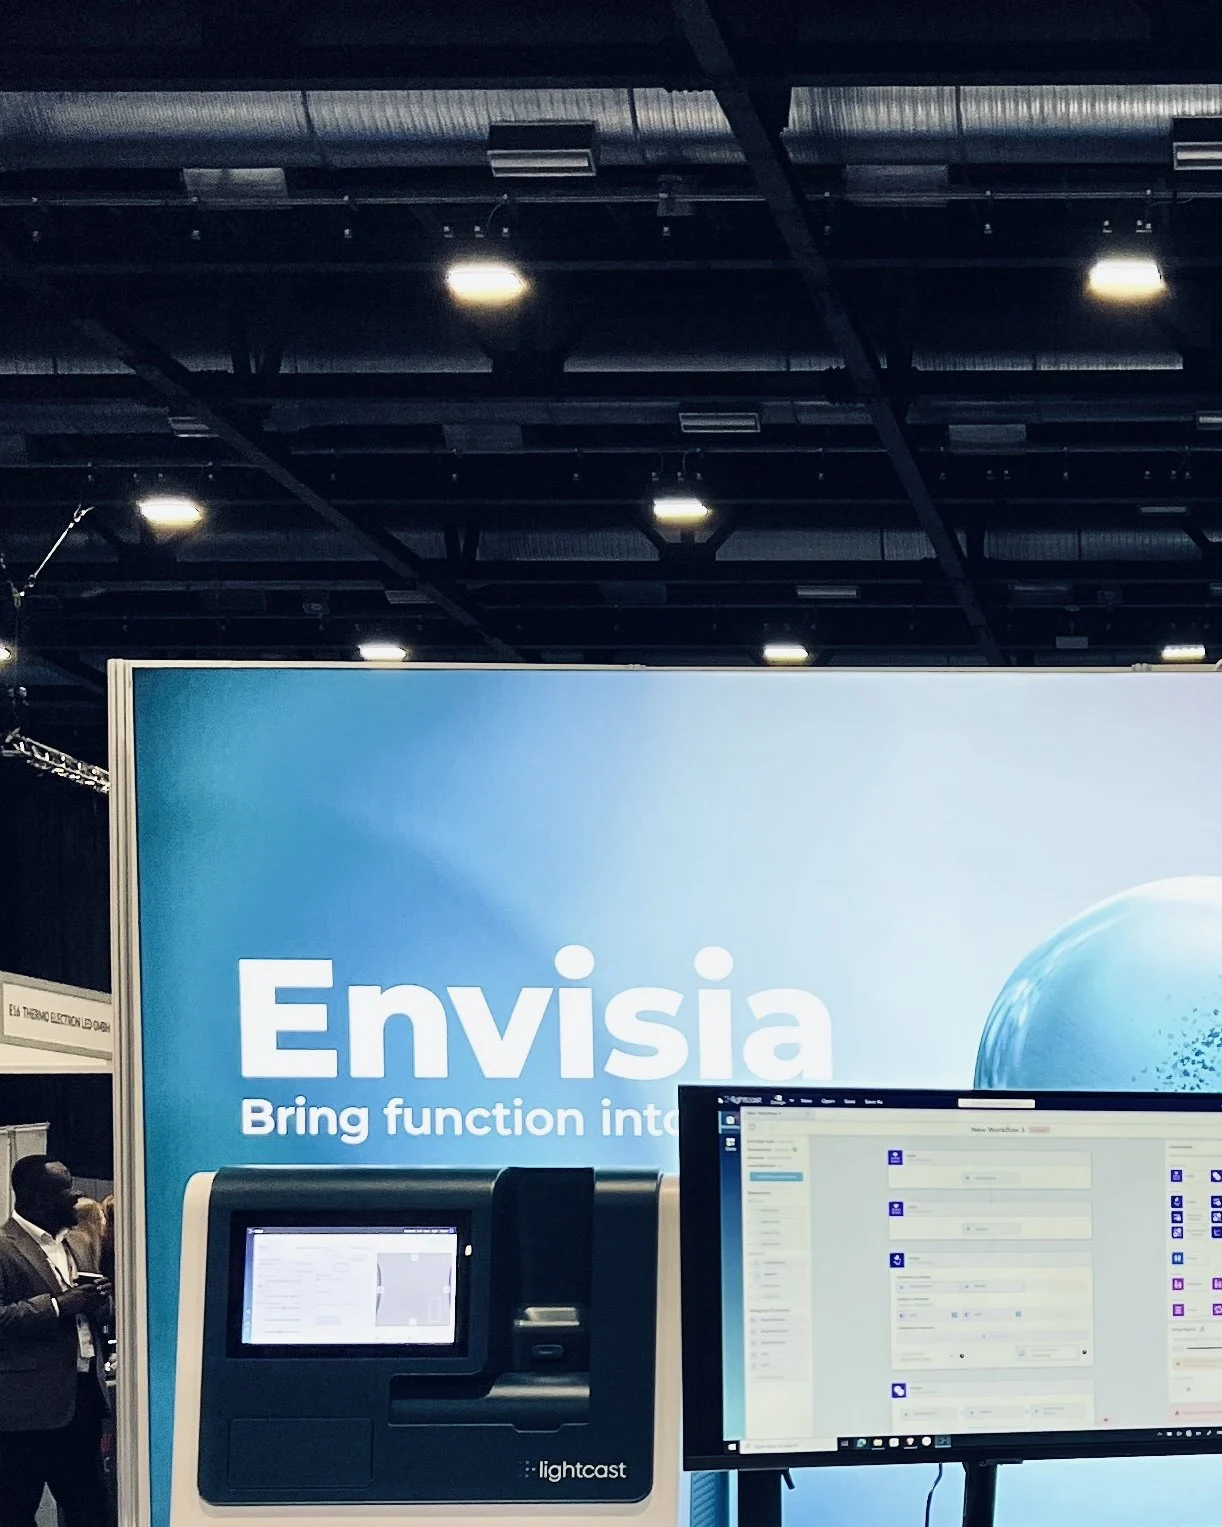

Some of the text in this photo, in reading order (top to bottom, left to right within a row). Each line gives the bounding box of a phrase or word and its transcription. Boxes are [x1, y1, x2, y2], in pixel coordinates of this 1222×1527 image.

[50, 1012, 80, 1027] ELECTRON
[238, 945, 833, 1081] Envisia
[241, 1098, 370, 1144] Bring
[386, 1096, 585, 1137] function
[538, 1460, 627, 1483] lightcast
